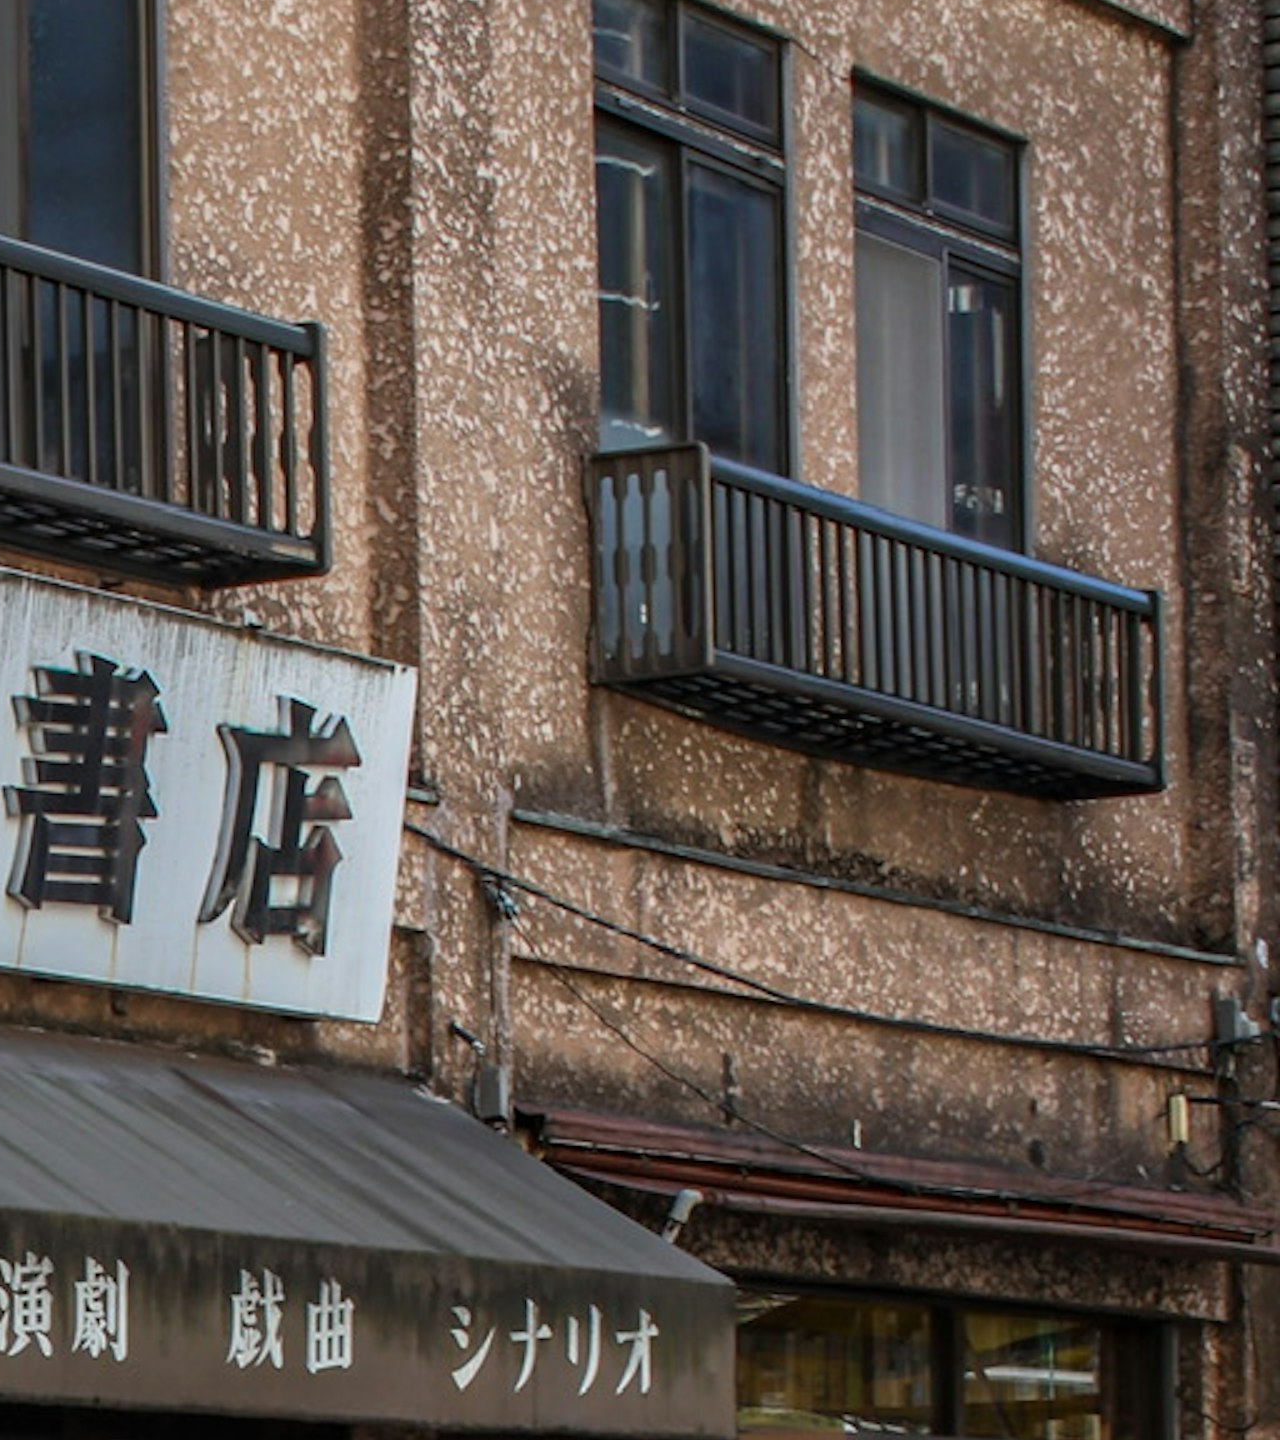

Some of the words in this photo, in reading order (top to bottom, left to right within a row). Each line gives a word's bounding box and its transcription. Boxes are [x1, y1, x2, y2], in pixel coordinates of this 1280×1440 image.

[226, 1267, 355, 1373] 戯曲
[449, 1297, 660, 1397] シナリオ
